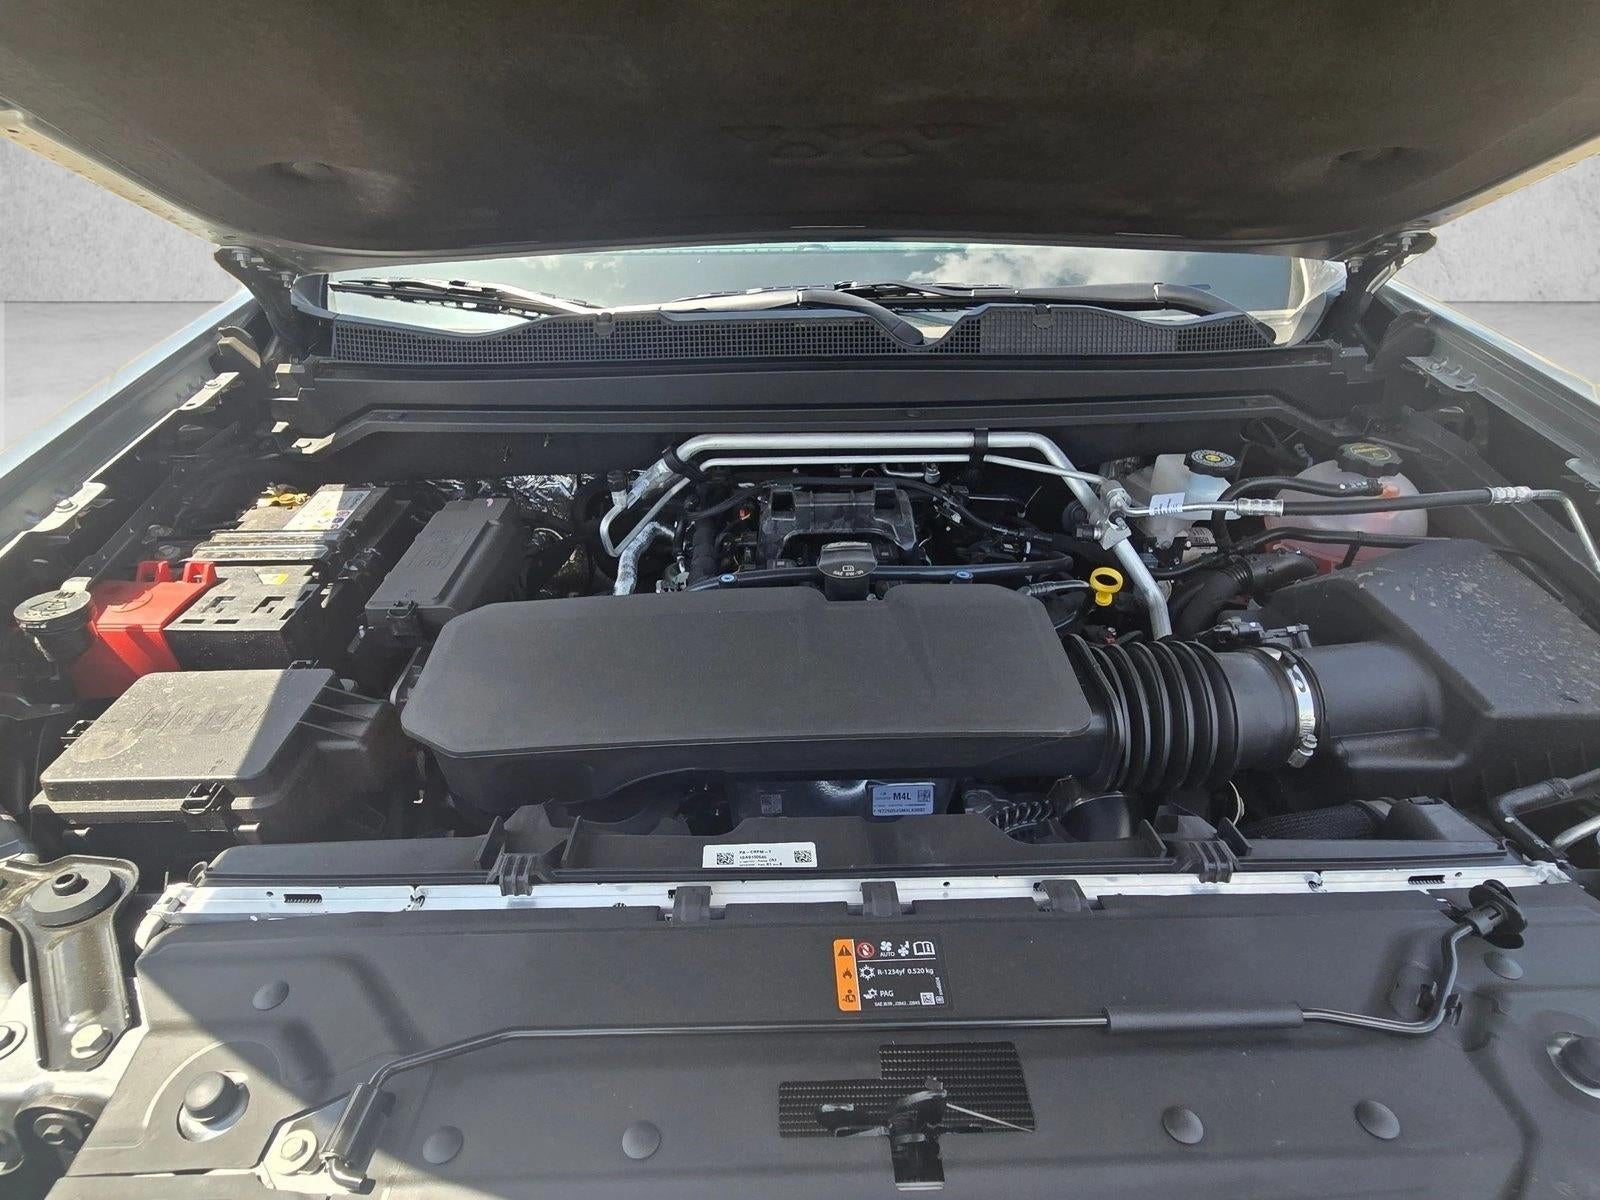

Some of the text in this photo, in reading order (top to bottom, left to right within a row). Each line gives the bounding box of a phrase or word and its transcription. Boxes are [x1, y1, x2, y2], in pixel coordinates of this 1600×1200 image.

[892, 792, 912, 801] M4L
[877, 967, 934, 976] R-1234yf 0.520 kg
[880, 990, 894, 998] PAG
